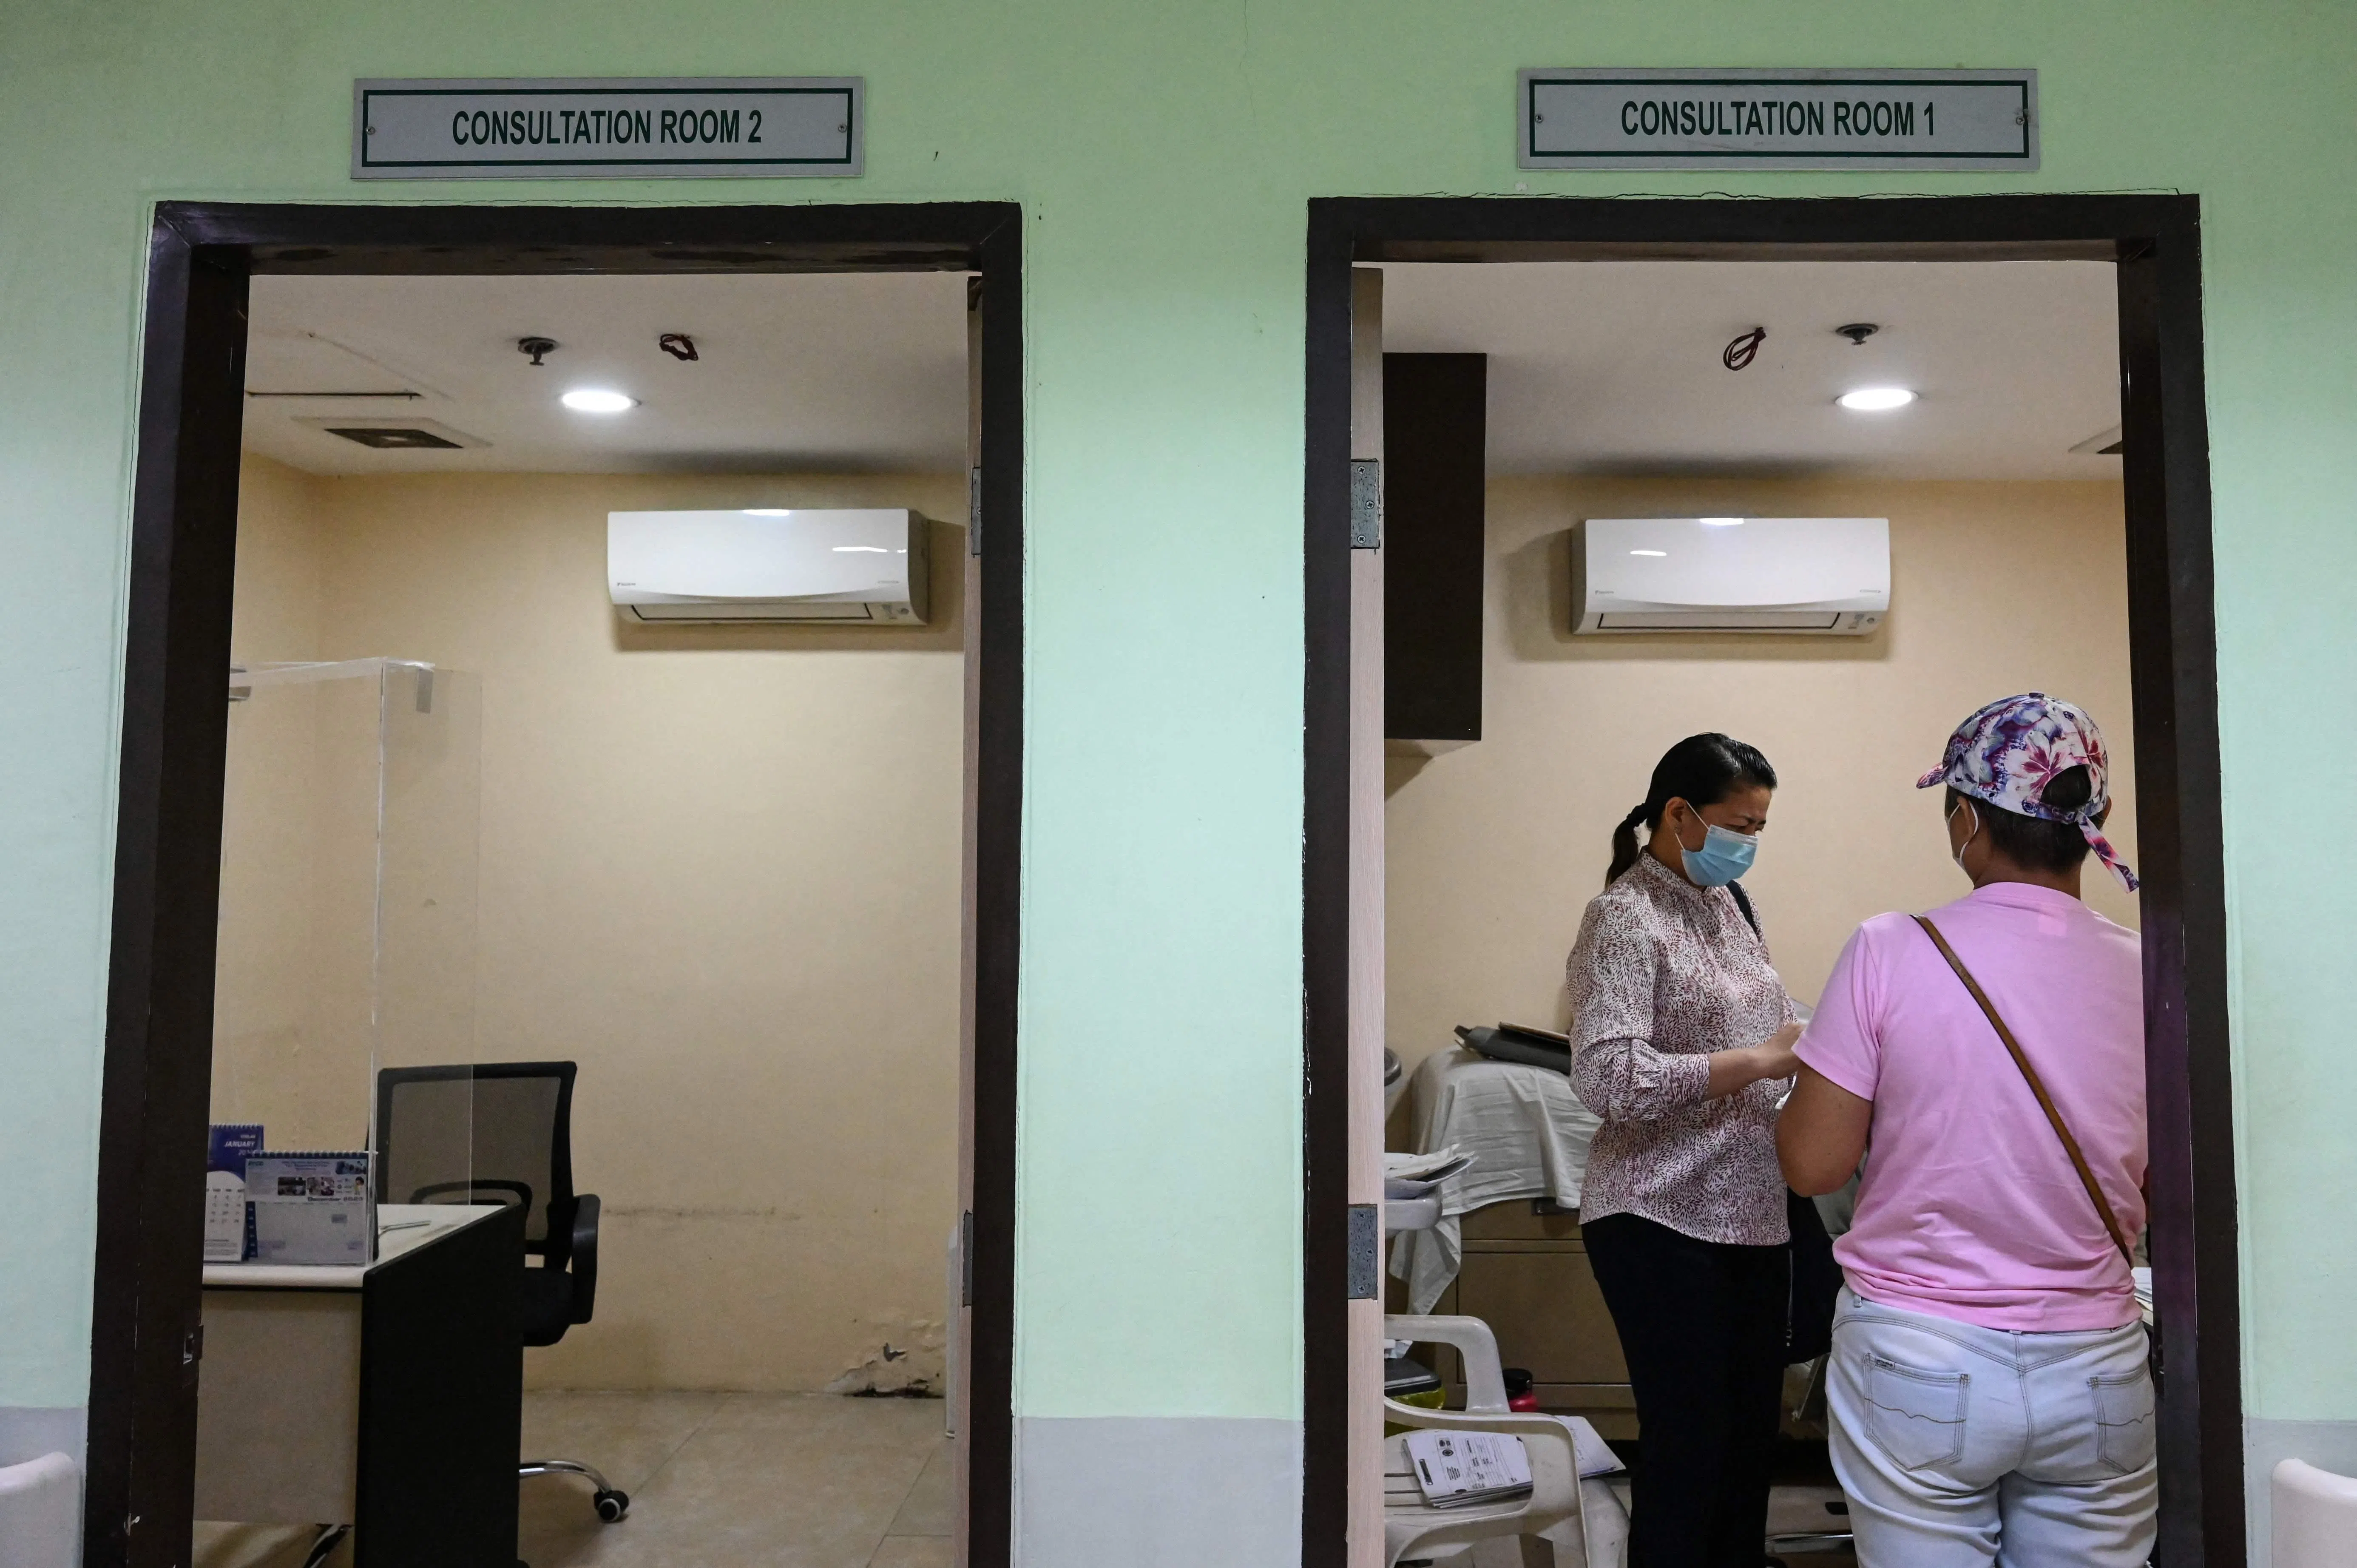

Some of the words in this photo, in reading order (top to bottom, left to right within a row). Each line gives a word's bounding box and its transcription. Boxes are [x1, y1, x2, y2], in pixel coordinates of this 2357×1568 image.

[452, 110, 651, 145] CONSULTATION
[660, 109, 740, 143] ROOM
[748, 110, 762, 143] 2
[1621, 101, 1824, 136] CONSULTATION
[1834, 101, 1914, 136] ROOM
[1924, 102, 1934, 136] 1
